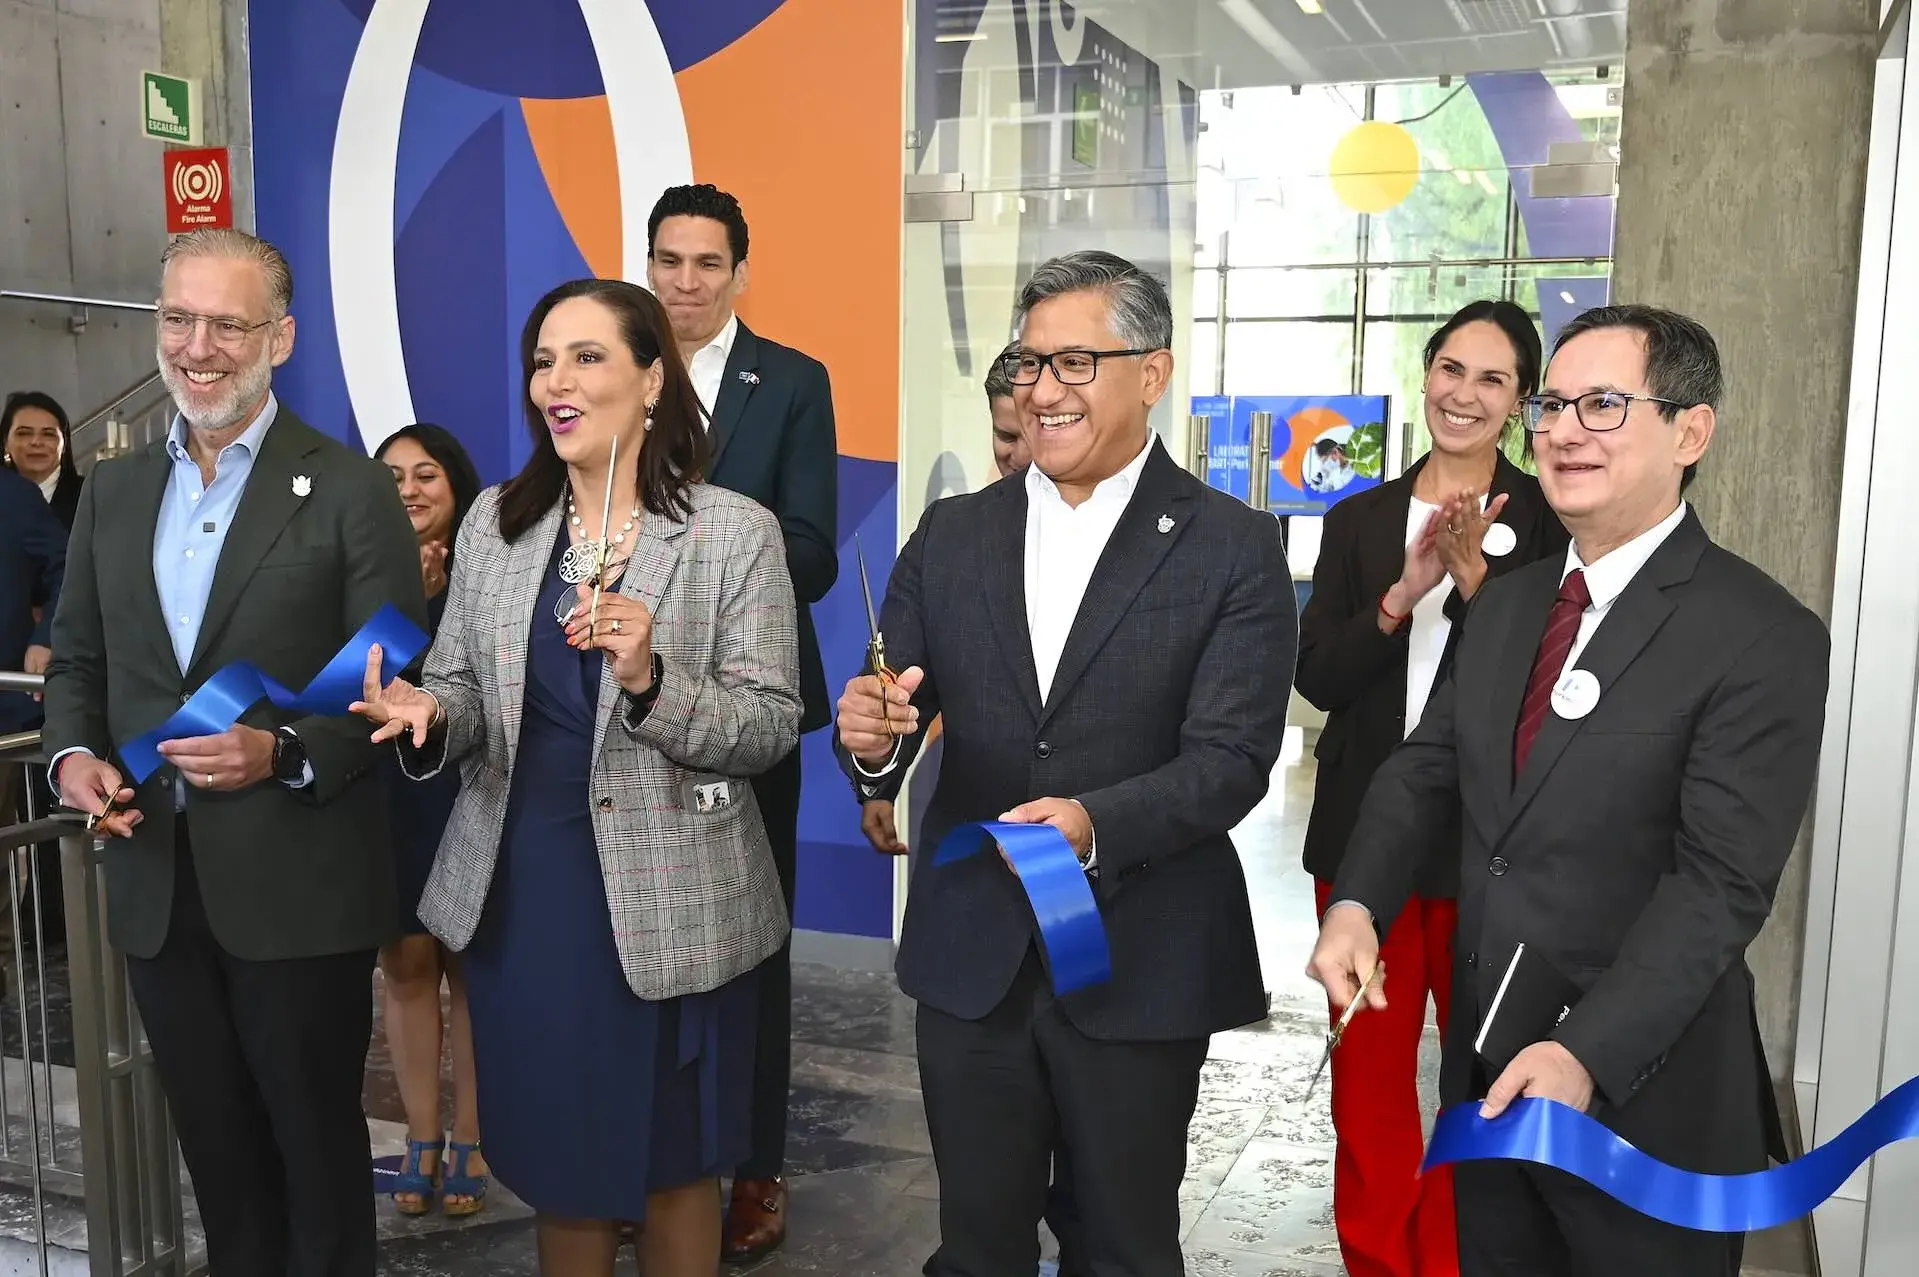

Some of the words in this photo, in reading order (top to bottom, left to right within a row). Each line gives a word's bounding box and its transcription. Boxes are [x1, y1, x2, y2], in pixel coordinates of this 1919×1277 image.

[149, 120, 188, 136] ESCALERAS
[187, 204, 211, 212] Alarma
[182, 215, 195, 223] Fire
[196, 214, 216, 223] Alarm
